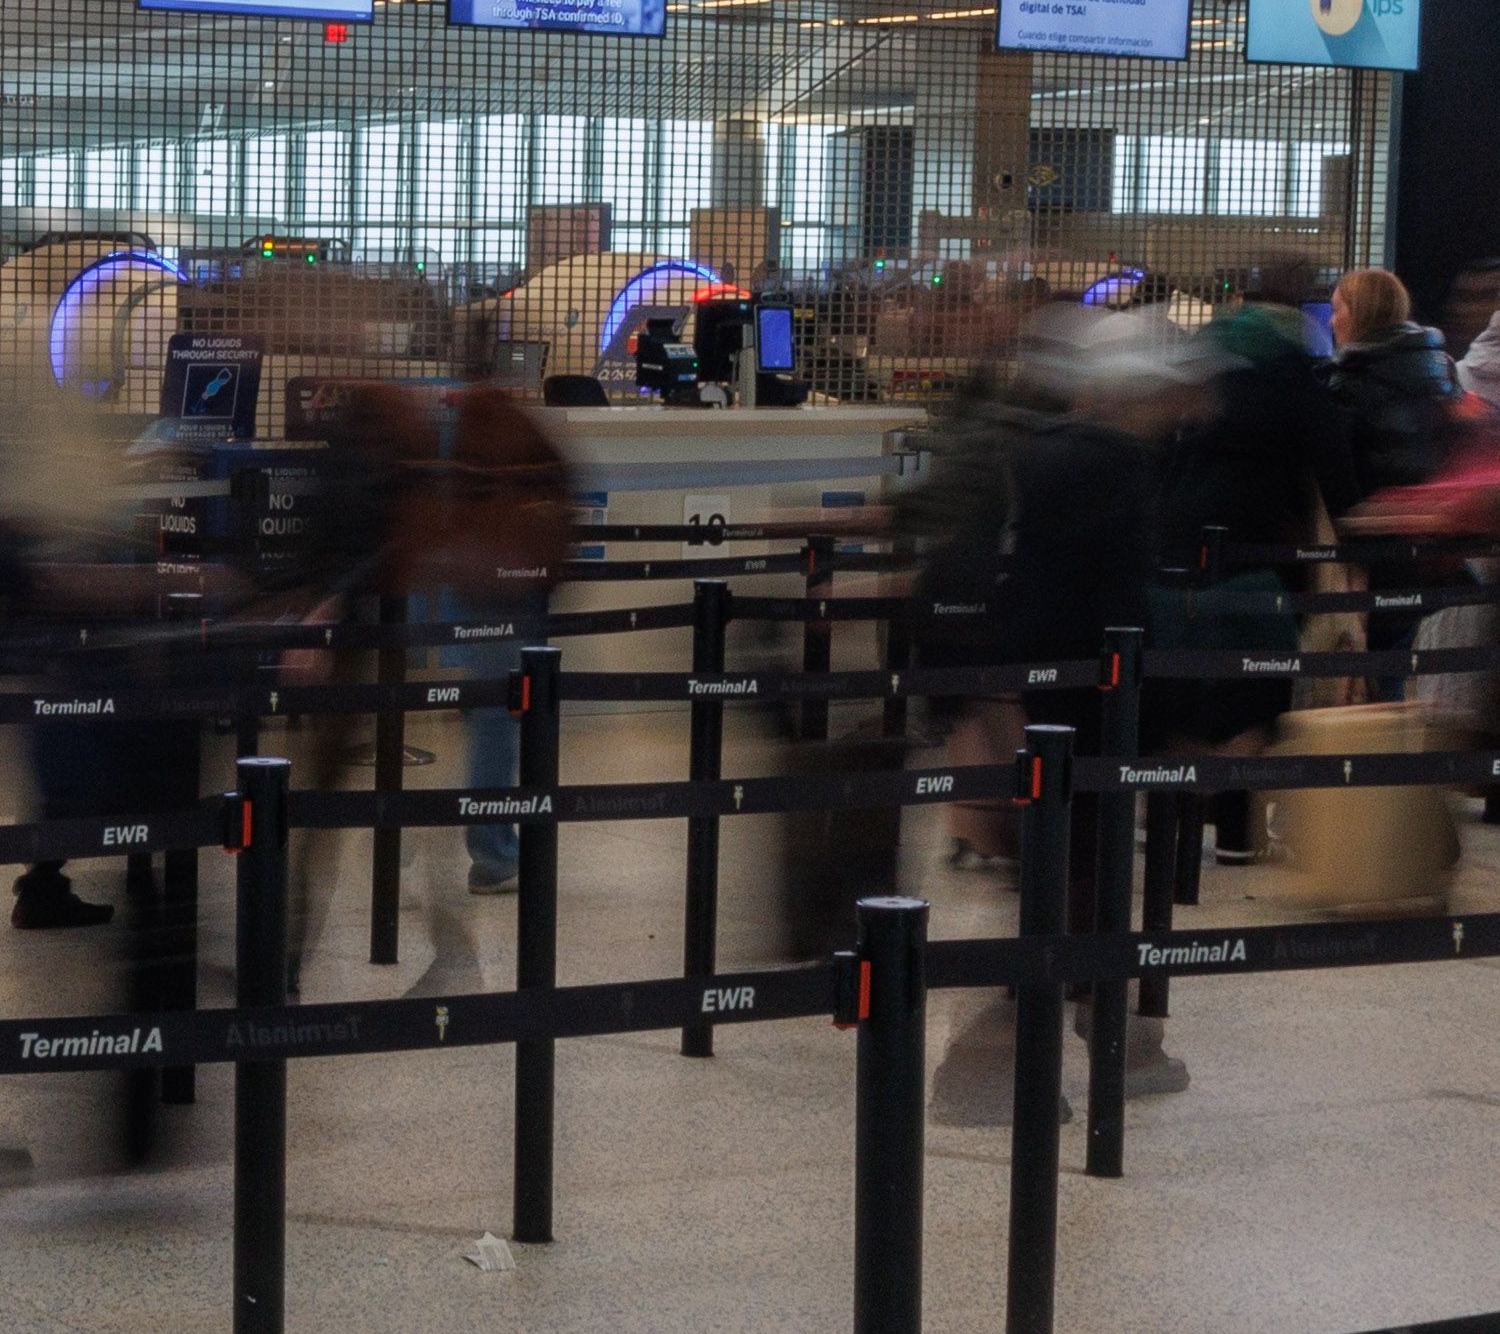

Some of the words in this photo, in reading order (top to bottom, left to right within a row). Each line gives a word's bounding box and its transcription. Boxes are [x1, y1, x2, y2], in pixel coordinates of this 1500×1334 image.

[492, 7, 533, 21] through
[534, 8, 556, 22] TSA
[191, 338, 205, 348] NO
[207, 338, 242, 348] LIQUIDS
[172, 349, 215, 360] THROUGH
[216, 349, 260, 360] SECURITY
[269, 493, 294, 510] NO
[916, 776, 953, 793] EWR
[459, 796, 537, 815] Terminal
[538, 796, 552, 813] A
[103, 825, 148, 845] EWR
[1138, 940, 1229, 965] Terminal
[1230, 939, 1246, 961] A
[702, 987, 755, 1012] EWR
[20, 1028, 140, 1058] Terminal
[142, 1028, 162, 1052] A
